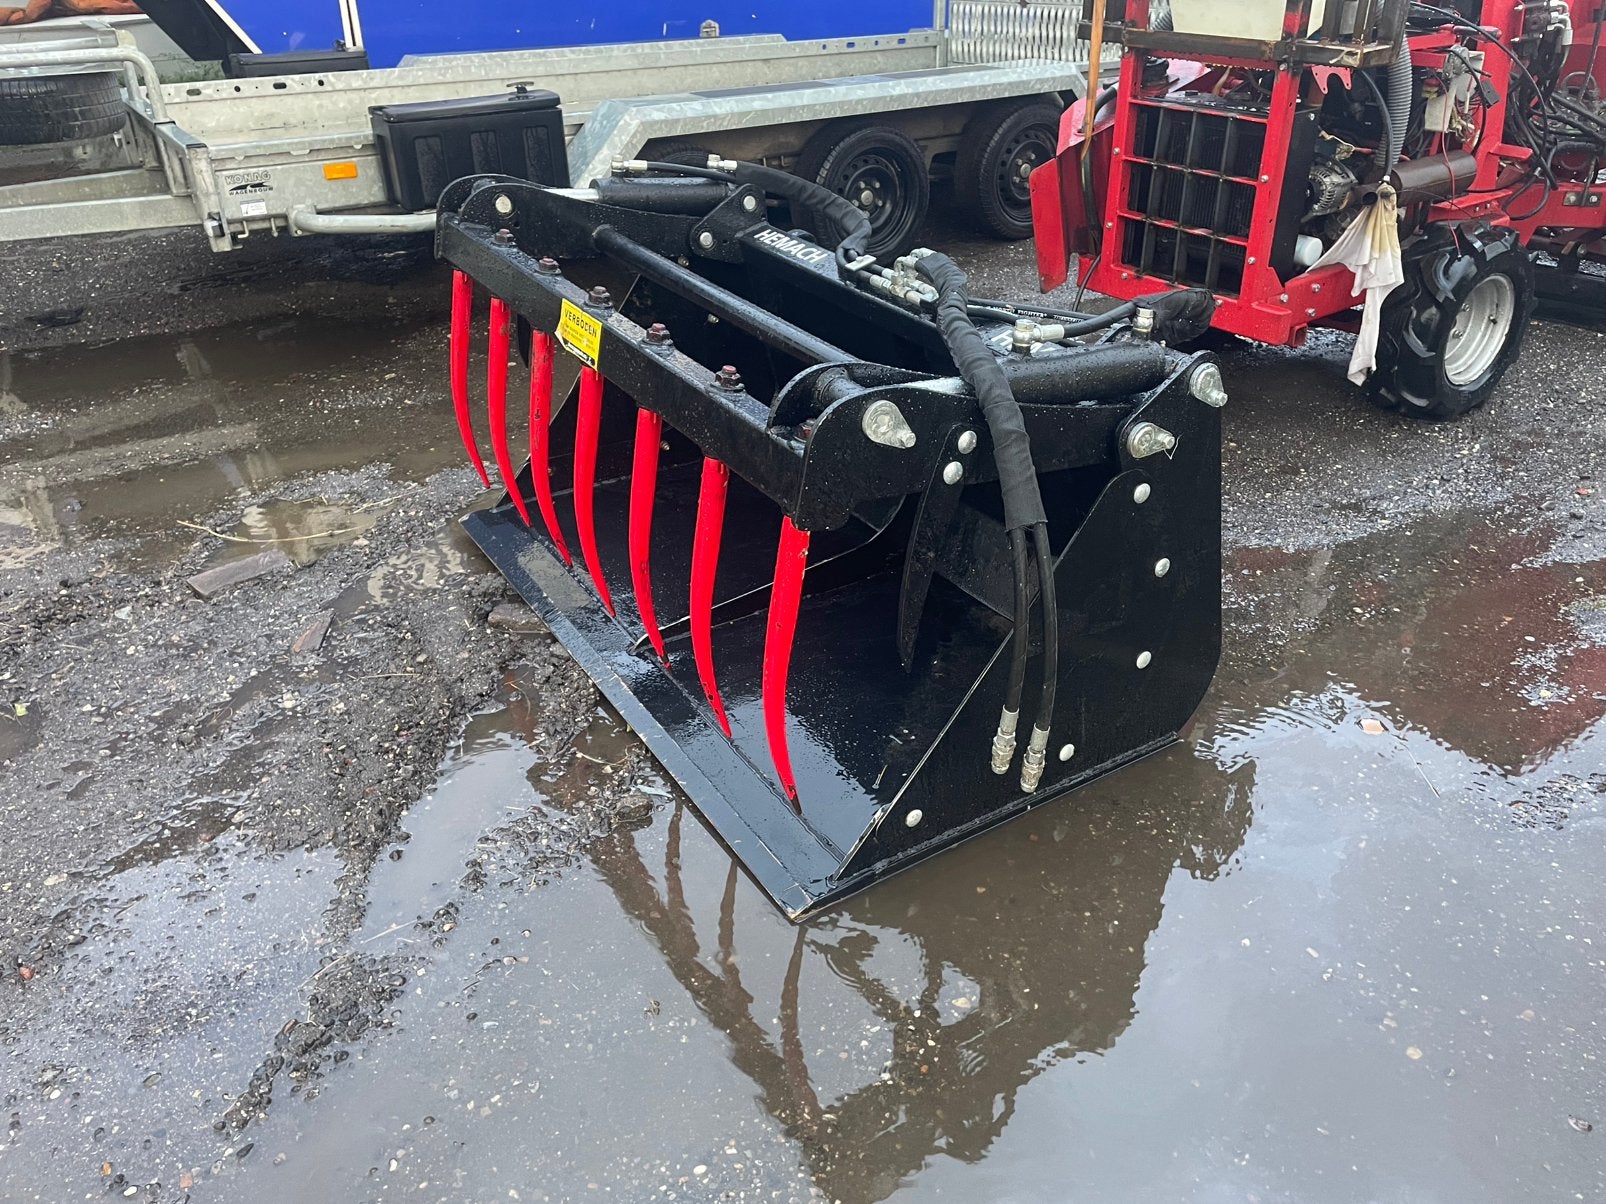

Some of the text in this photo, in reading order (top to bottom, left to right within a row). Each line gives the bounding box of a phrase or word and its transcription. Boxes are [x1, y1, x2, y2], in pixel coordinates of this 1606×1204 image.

[225, 170, 271, 185] KONAG
[229, 186, 273, 196] WAGENBOUW
[753, 229, 829, 263] HEMACH
[565, 308, 597, 338] VERBODEN
